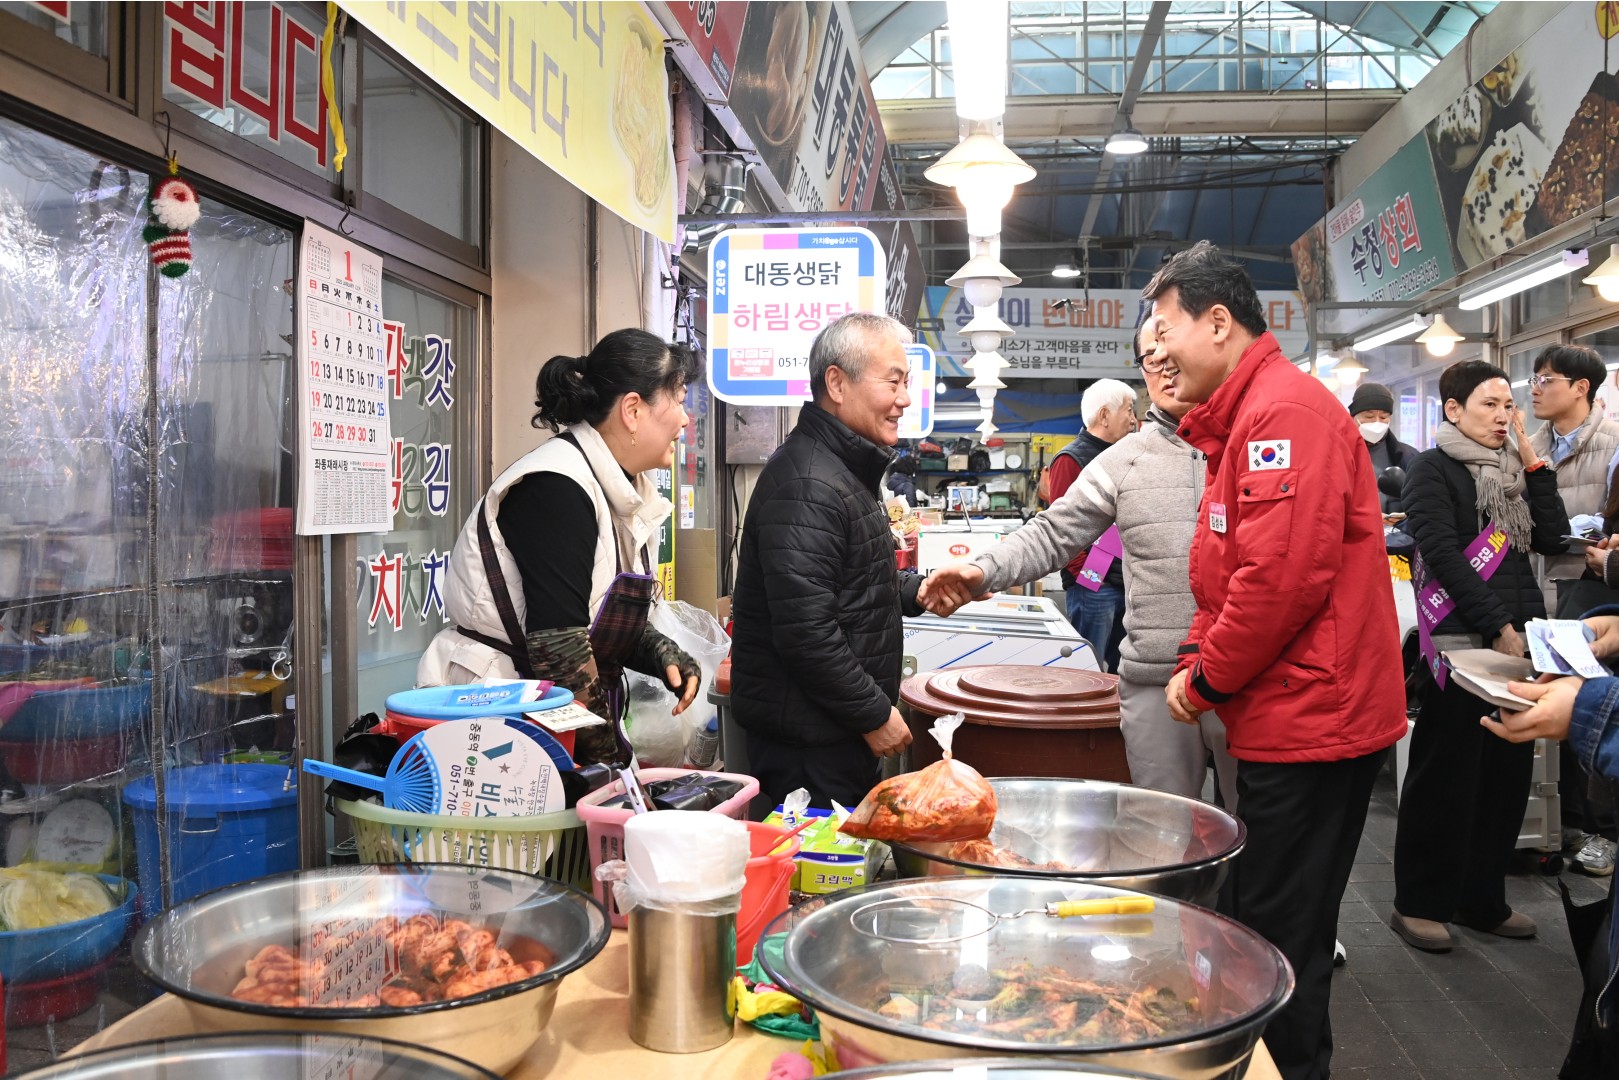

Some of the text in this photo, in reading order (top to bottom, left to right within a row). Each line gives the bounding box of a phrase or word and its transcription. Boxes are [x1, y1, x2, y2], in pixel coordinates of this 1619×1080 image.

[1350, 191, 1423, 288] 수정상회
[344, 250, 353, 282] 1
[744, 261, 841, 287] 대동생닭
[358, 315, 363, 330] 2
[367, 318, 372, 333] 3
[311, 330, 383, 363] 5 6 7 8 9 10 11
[1034, 339, 1092, 353] 고객마음을
[1095, 339, 1118, 353] 산다
[310, 360, 384, 390] 12 13 14 15 16 17 18
[1008, 356, 1080, 369] 손님을 부른다
[311, 391, 385, 417] 19 20 21 22 23 24 25
[312, 421, 376, 443] 26 27 28 29 30 31
[468, 723, 482, 752] 중동역
[462, 779, 474, 798] 출구
